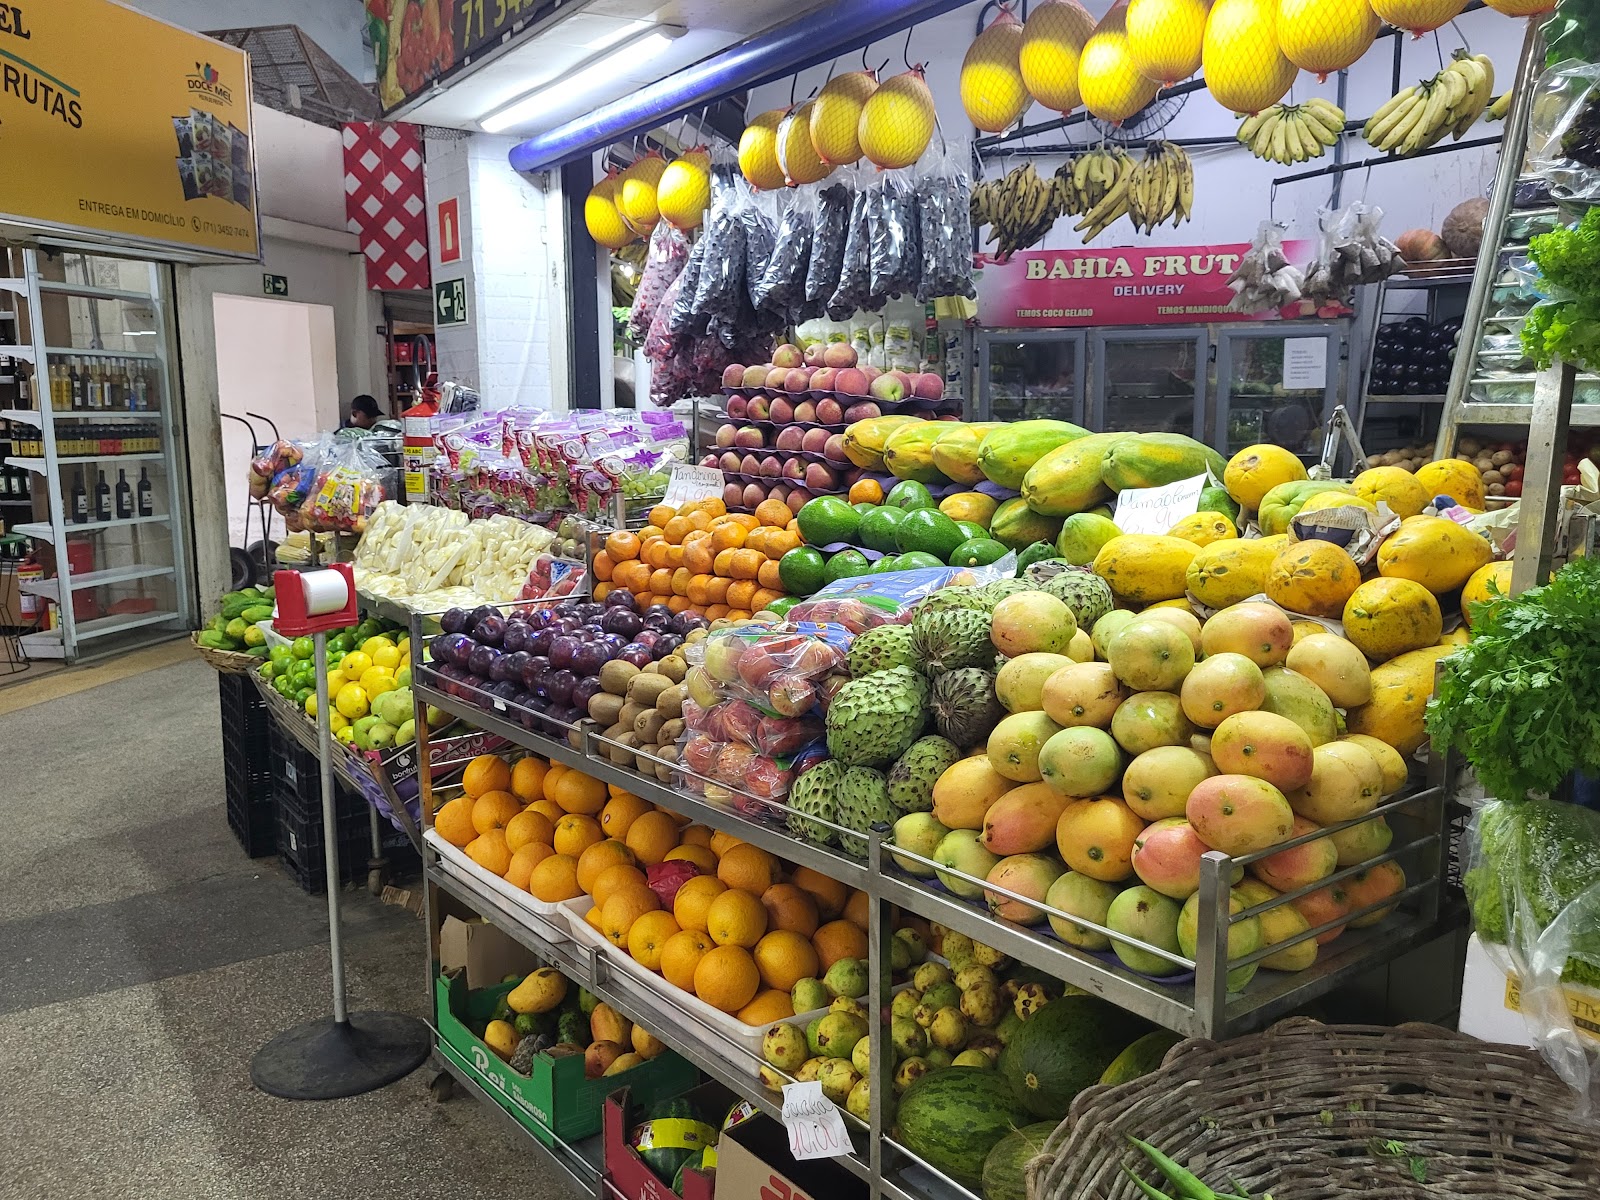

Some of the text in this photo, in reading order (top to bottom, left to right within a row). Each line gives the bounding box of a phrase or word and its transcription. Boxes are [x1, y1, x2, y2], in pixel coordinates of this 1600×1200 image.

[0, 62, 83, 129] RUTAS
[188, 79, 213, 92] DOCE
[215, 85, 232, 103] MEL
[79, 199, 124, 217] ENTREGA
[127, 207, 140, 219] EM
[141, 210, 186, 228] DOMICÍLIO
[203, 221, 217, 235] (71)
[1025, 253, 1240, 281] BAHIA FRUT
[1113, 283, 1185, 297] DELIVERY
[1016, 308, 1094, 318] TEMOS COCO GELADO
[1157, 305, 1185, 315] TEMOS
[792, 1117, 839, 1157] 10,00
